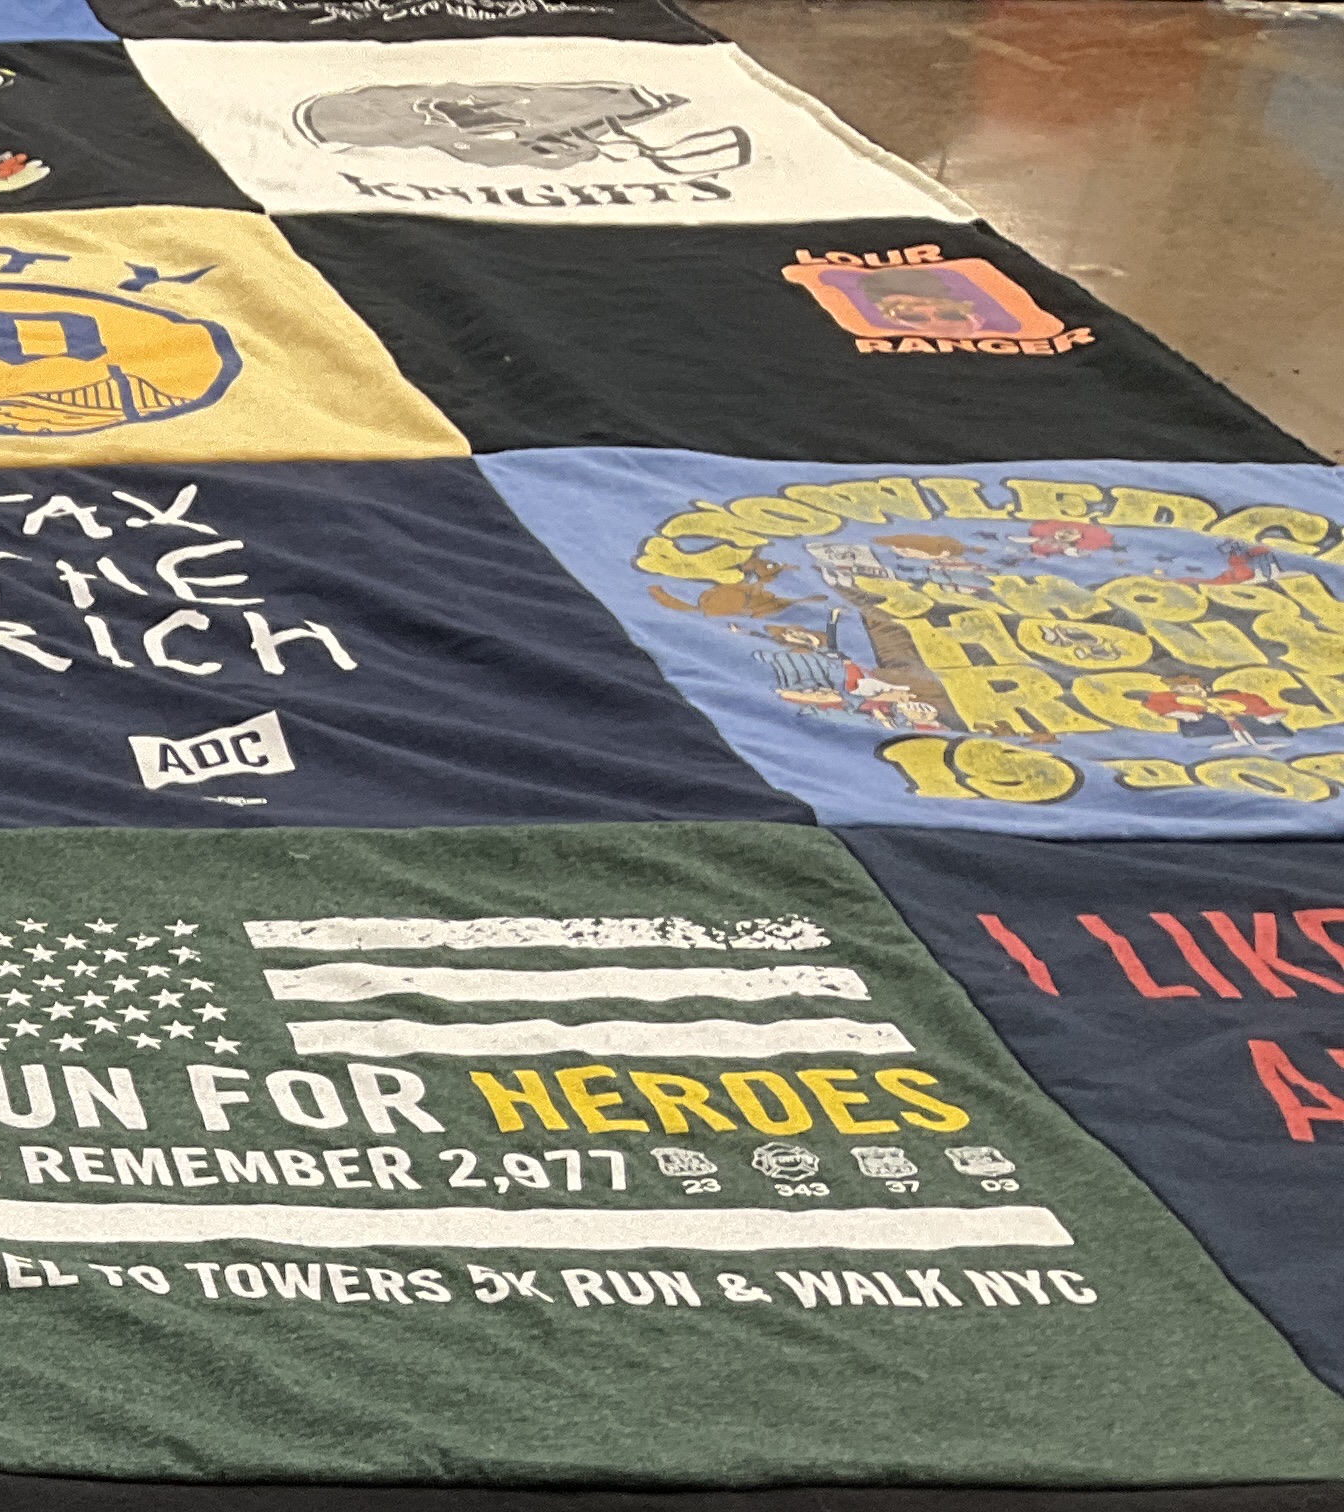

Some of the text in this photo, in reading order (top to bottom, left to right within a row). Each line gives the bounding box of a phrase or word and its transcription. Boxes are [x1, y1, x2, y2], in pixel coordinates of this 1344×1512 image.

[338, 172, 734, 206] KNIGHTS
[855, 327, 1095, 356] RANGER
[158, 730, 268, 774] AOC
[977, 913, 1059, 996] I
[192, 1062, 446, 1135] FOR
[469, 1064, 972, 1137] HEROES
[24, 1143, 417, 1190] REMEMBER
[443, 1147, 629, 1200] 2,977
[682, 1179, 721, 1194] 23
[885, 1180, 920, 1194] 37
[981, 1178, 1020, 1192] 03
[775, 1182, 830, 1197] 343
[93, 1263, 169, 1293] TO
[183, 1260, 451, 1305] TOWERS
[470, 1262, 555, 1307] 5K
[571, 1268, 700, 1308] RUN
[722, 1271, 769, 1306] &
[779, 1265, 956, 1308] WALK
[974, 1268, 1098, 1310] NYC
